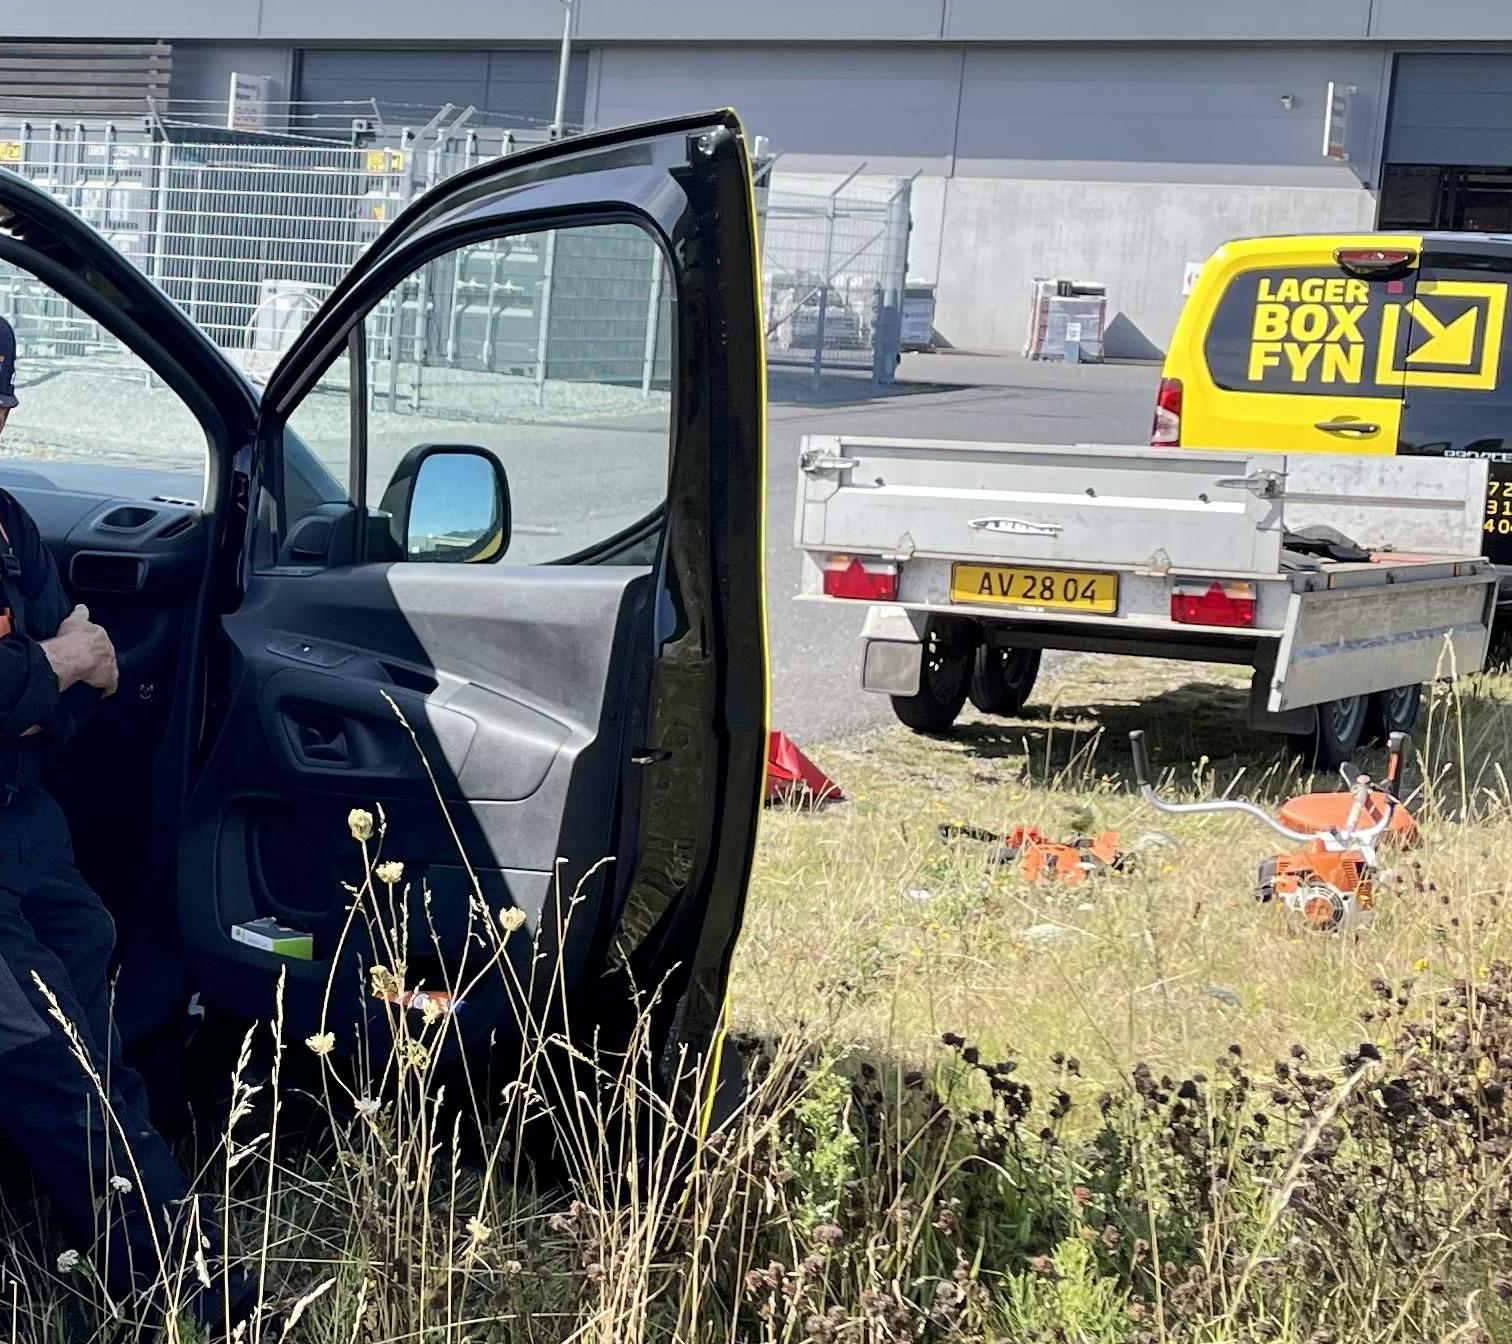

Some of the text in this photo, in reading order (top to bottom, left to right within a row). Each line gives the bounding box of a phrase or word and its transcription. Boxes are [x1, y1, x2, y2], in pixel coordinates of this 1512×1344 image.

[1256, 277, 1370, 304] LAGER
[1252, 303, 1369, 343] BOX
[1247, 342, 1366, 384] FYN
[978, 572, 1097, 604] AV 28 04
